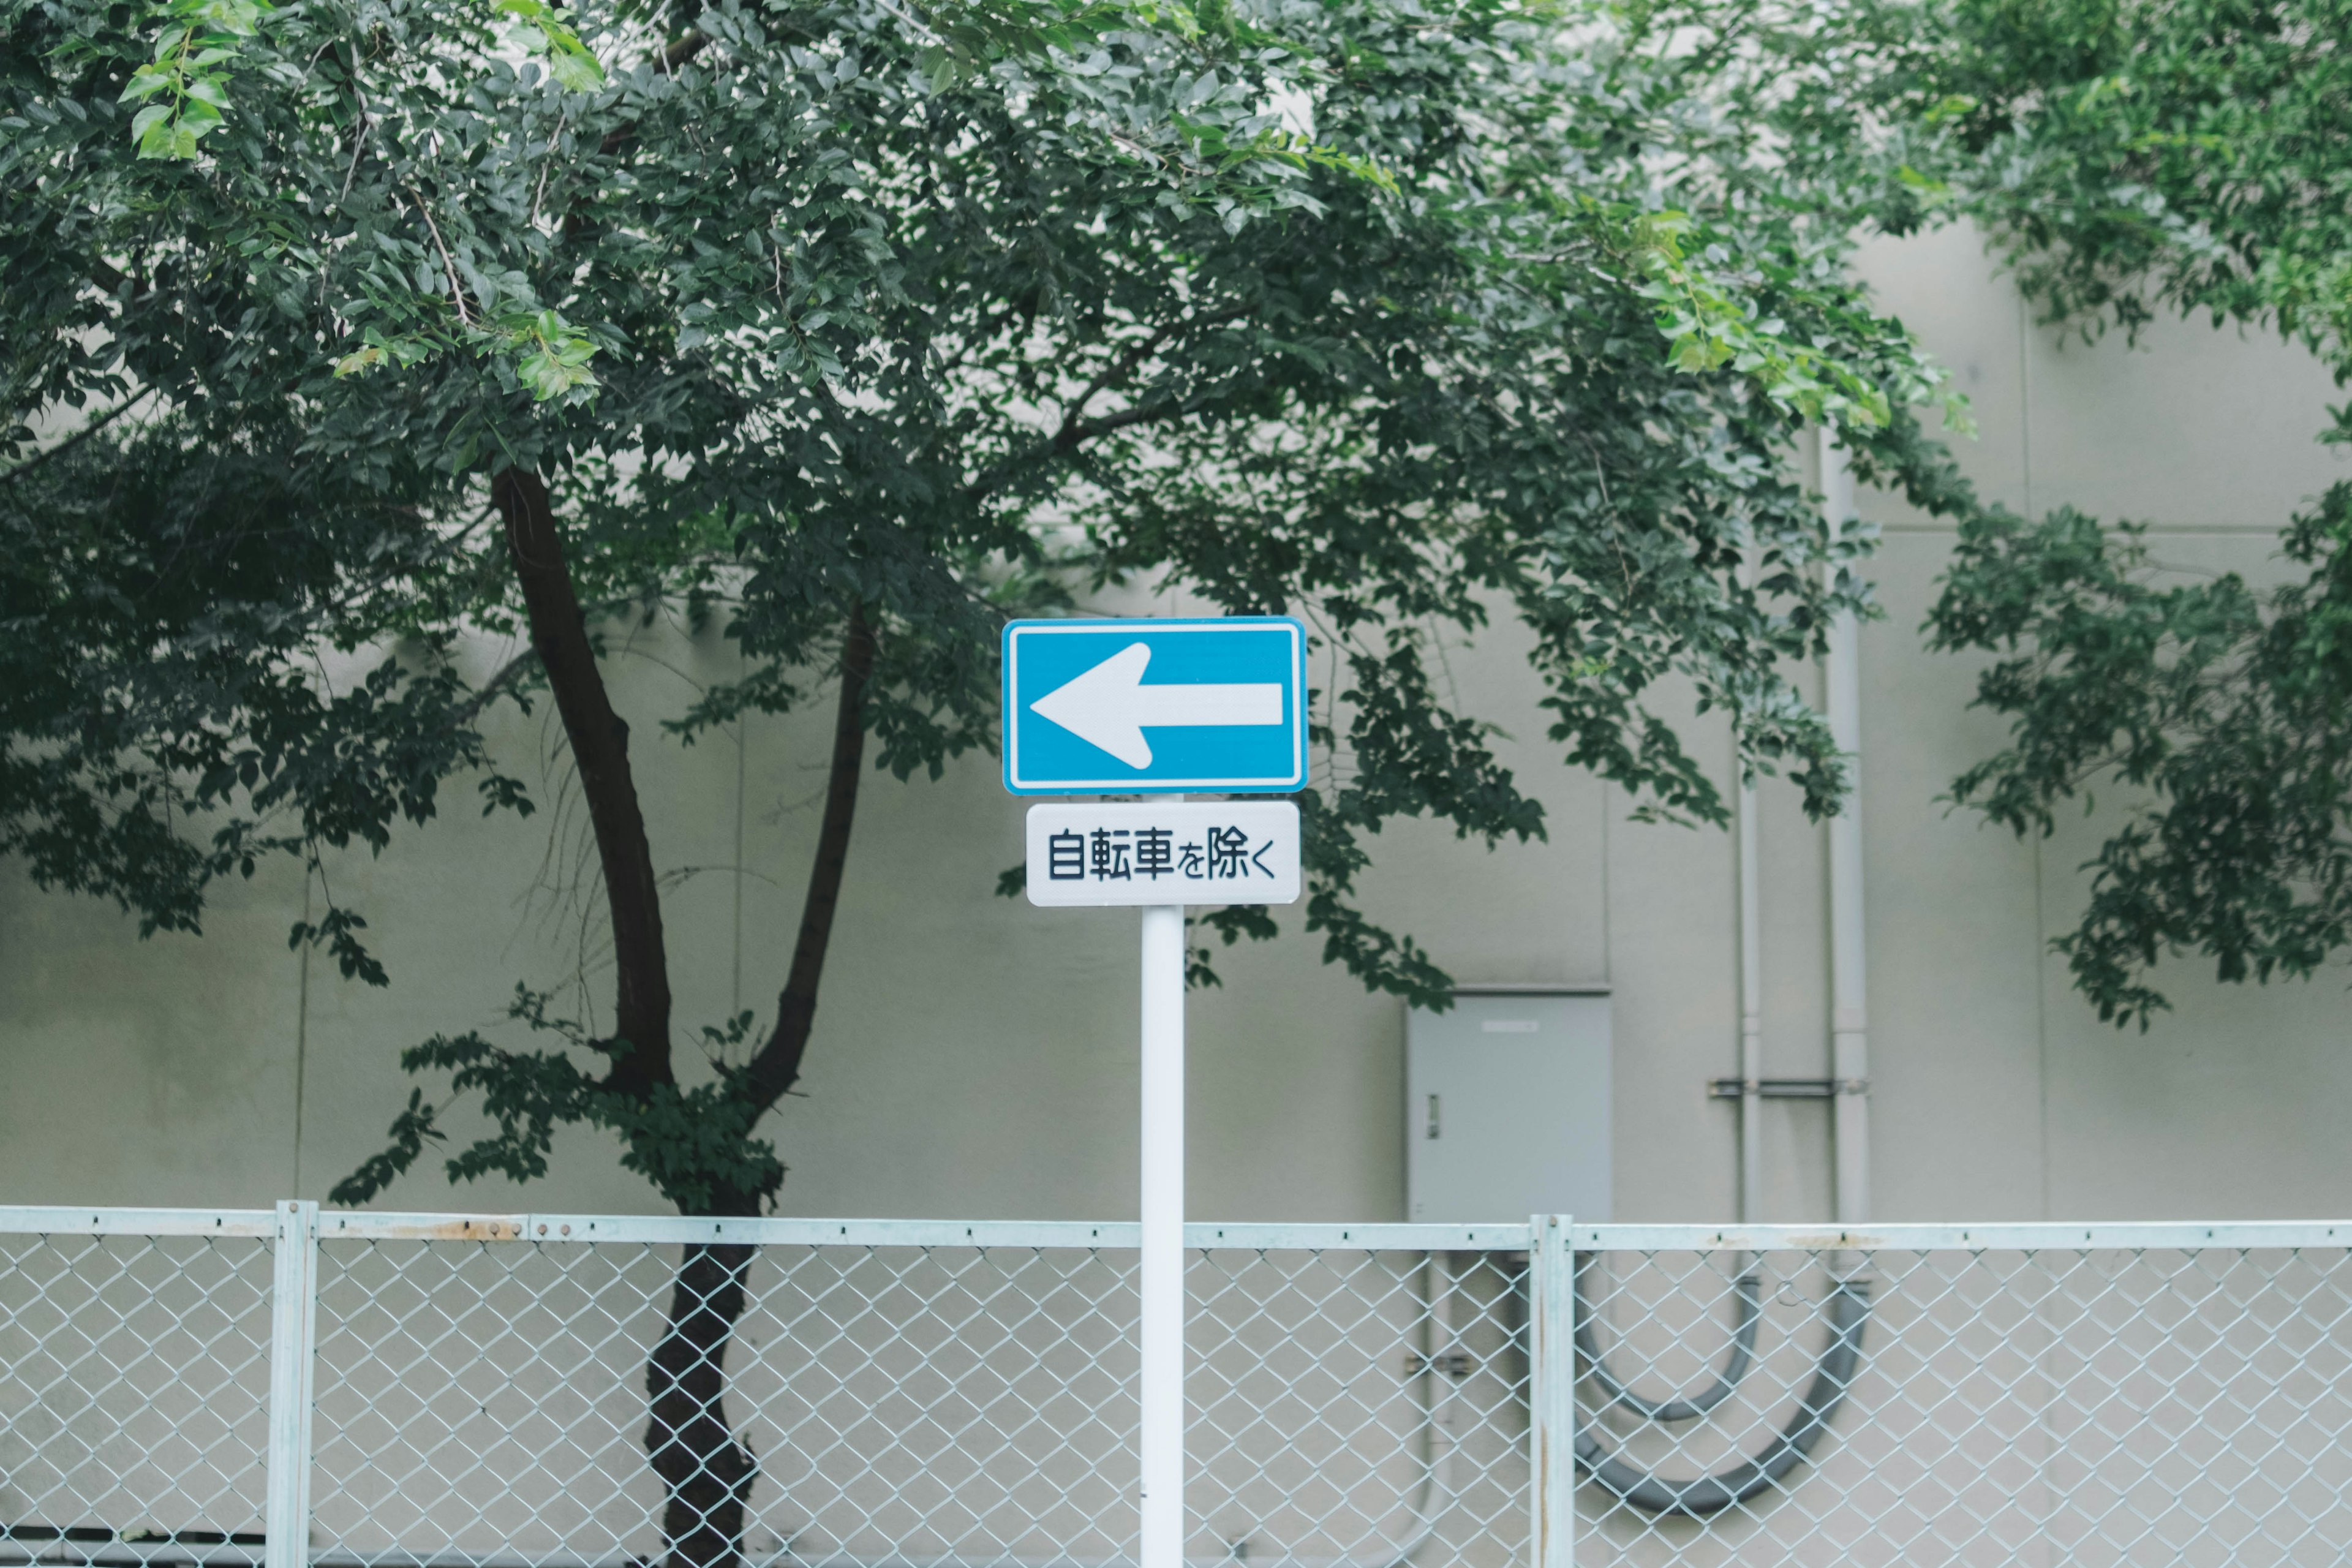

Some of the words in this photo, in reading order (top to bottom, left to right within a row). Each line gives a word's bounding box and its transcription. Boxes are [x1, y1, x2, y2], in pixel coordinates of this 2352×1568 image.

[1049, 826, 1275, 881] 自転車を除く
